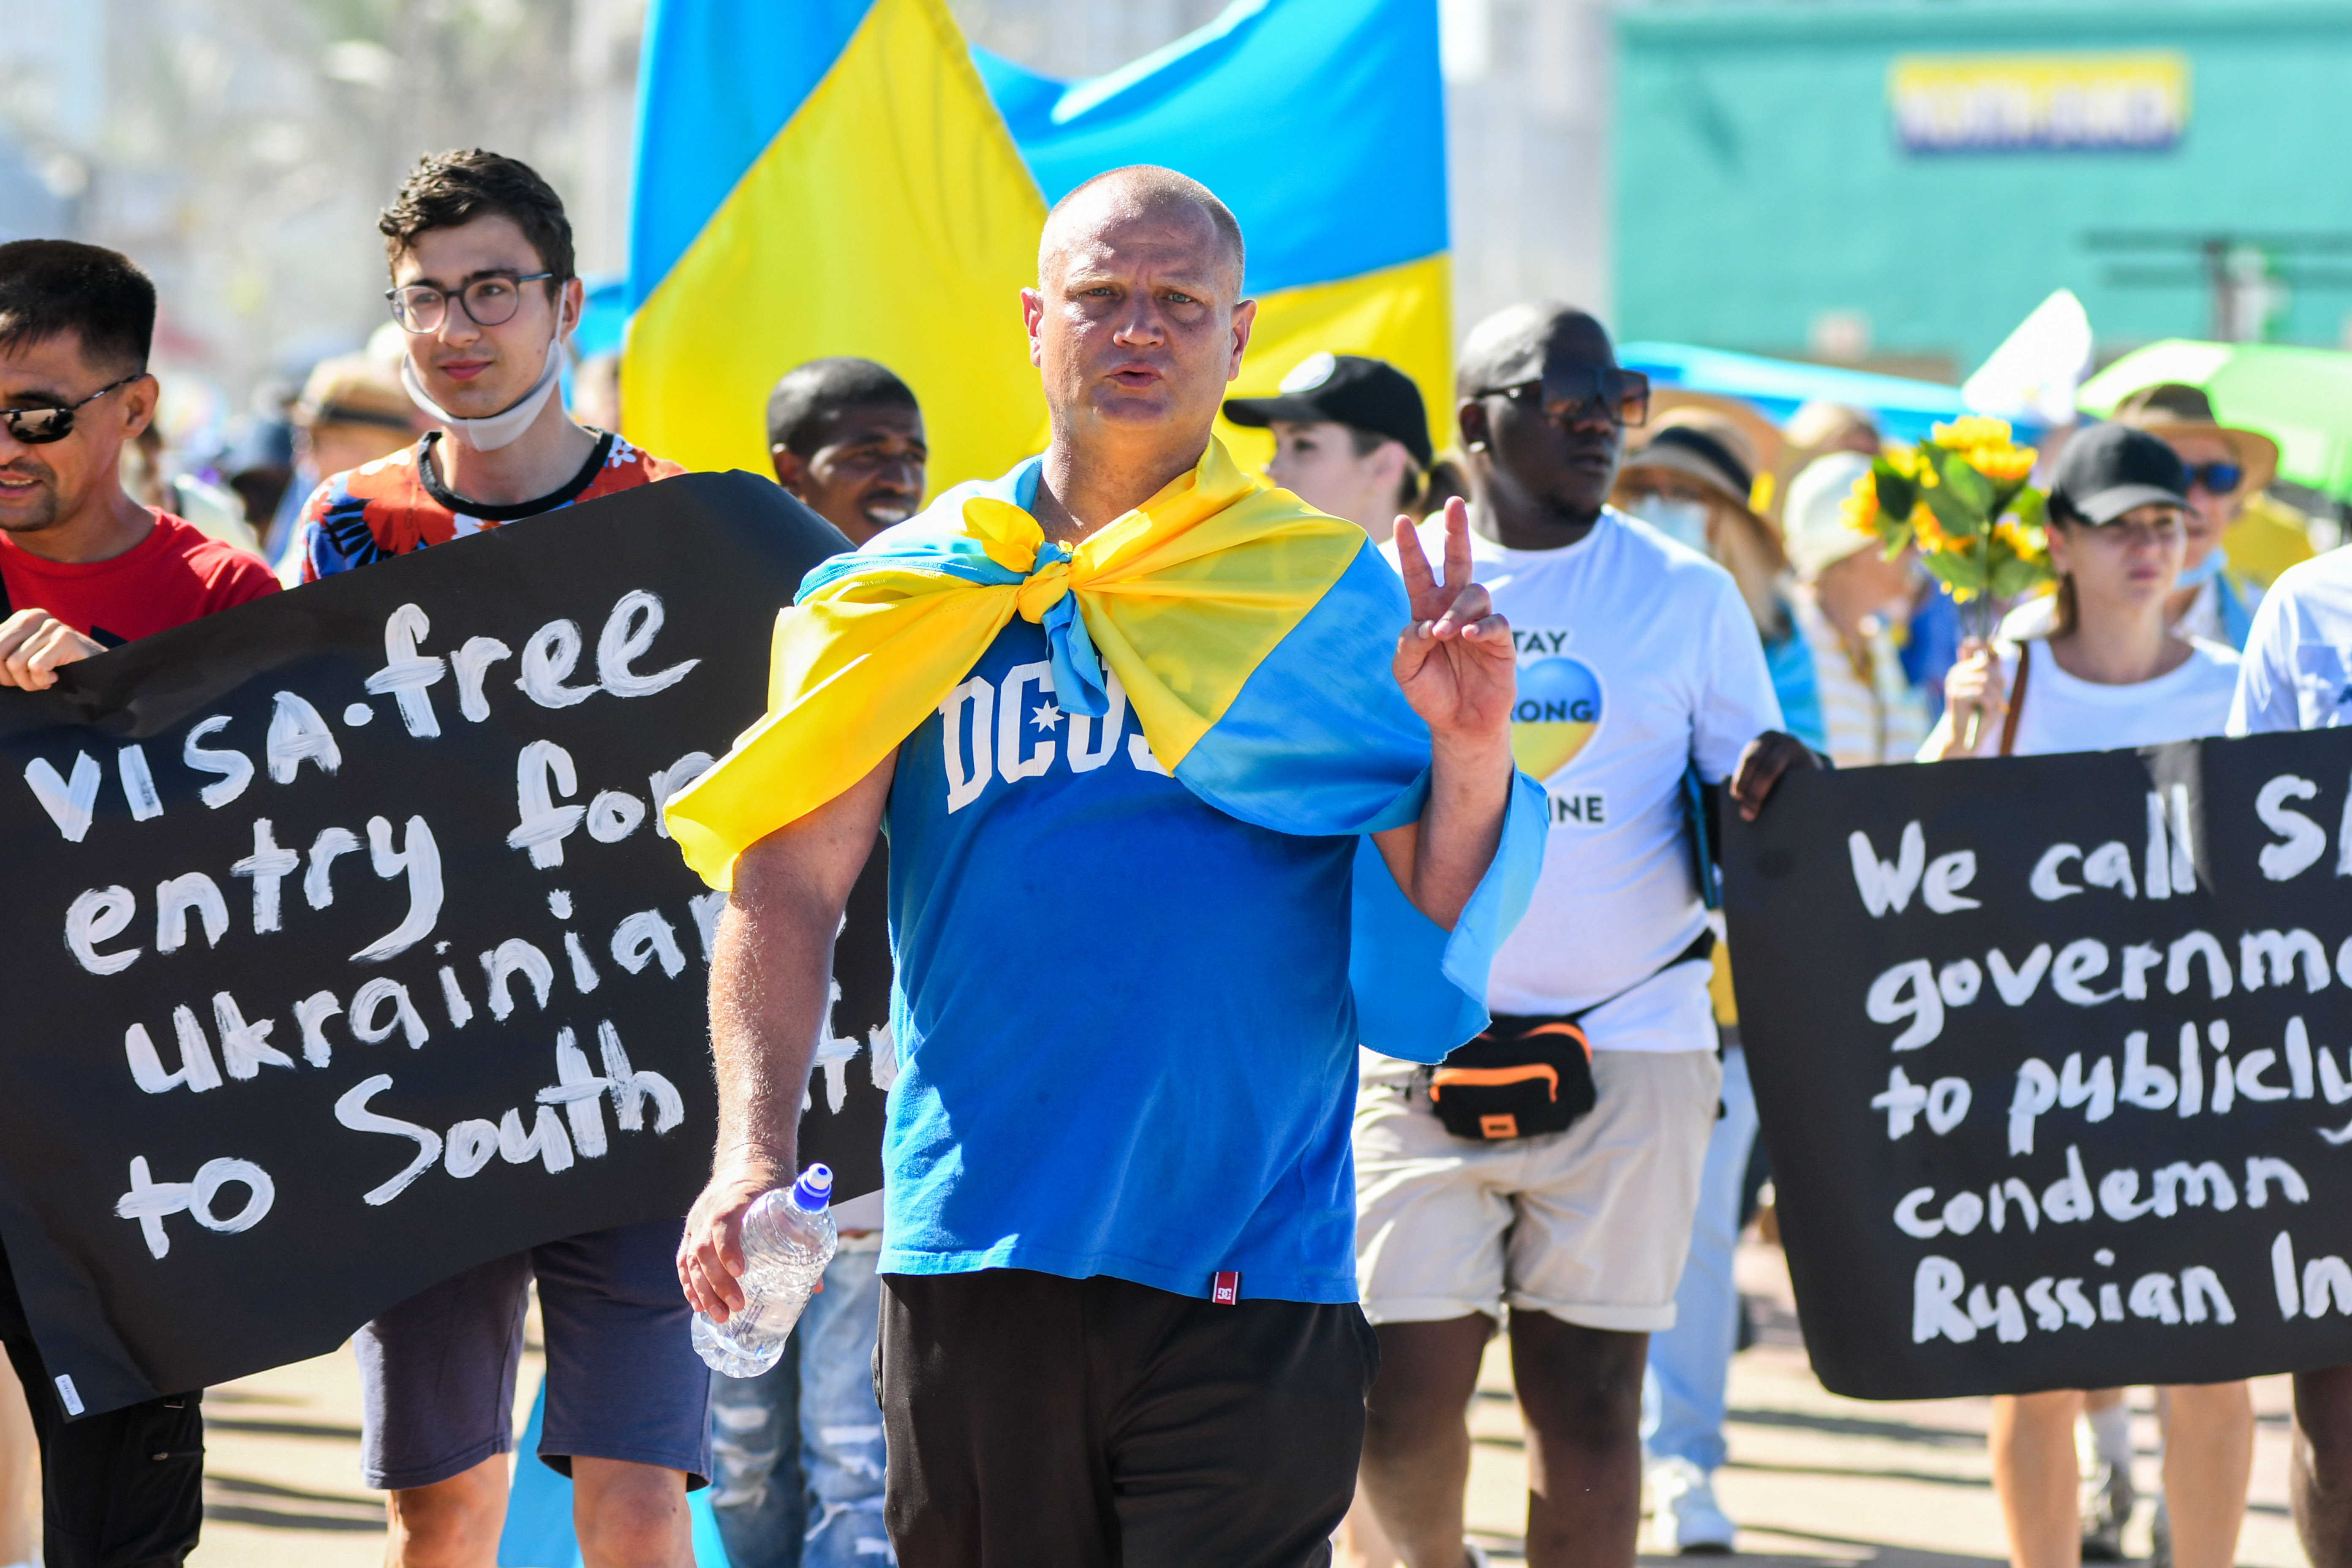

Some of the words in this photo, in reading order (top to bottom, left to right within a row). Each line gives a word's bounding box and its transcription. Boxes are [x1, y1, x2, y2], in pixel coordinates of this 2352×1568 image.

[1512, 631, 1567, 653] TAY
[65, 815, 444, 975] entry
[506, 740, 718, 870] for
[1848, 819, 1981, 917] We
[2030, 783, 2201, 901] call
[125, 889, 846, 1093] Ukrainia
[115, 1156, 275, 1260] to
[335, 1020, 684, 1206] South
[1871, 1066, 1972, 1140] to
[1893, 1145, 2310, 1239] condemn
[1912, 1248, 2237, 1344] Russian
